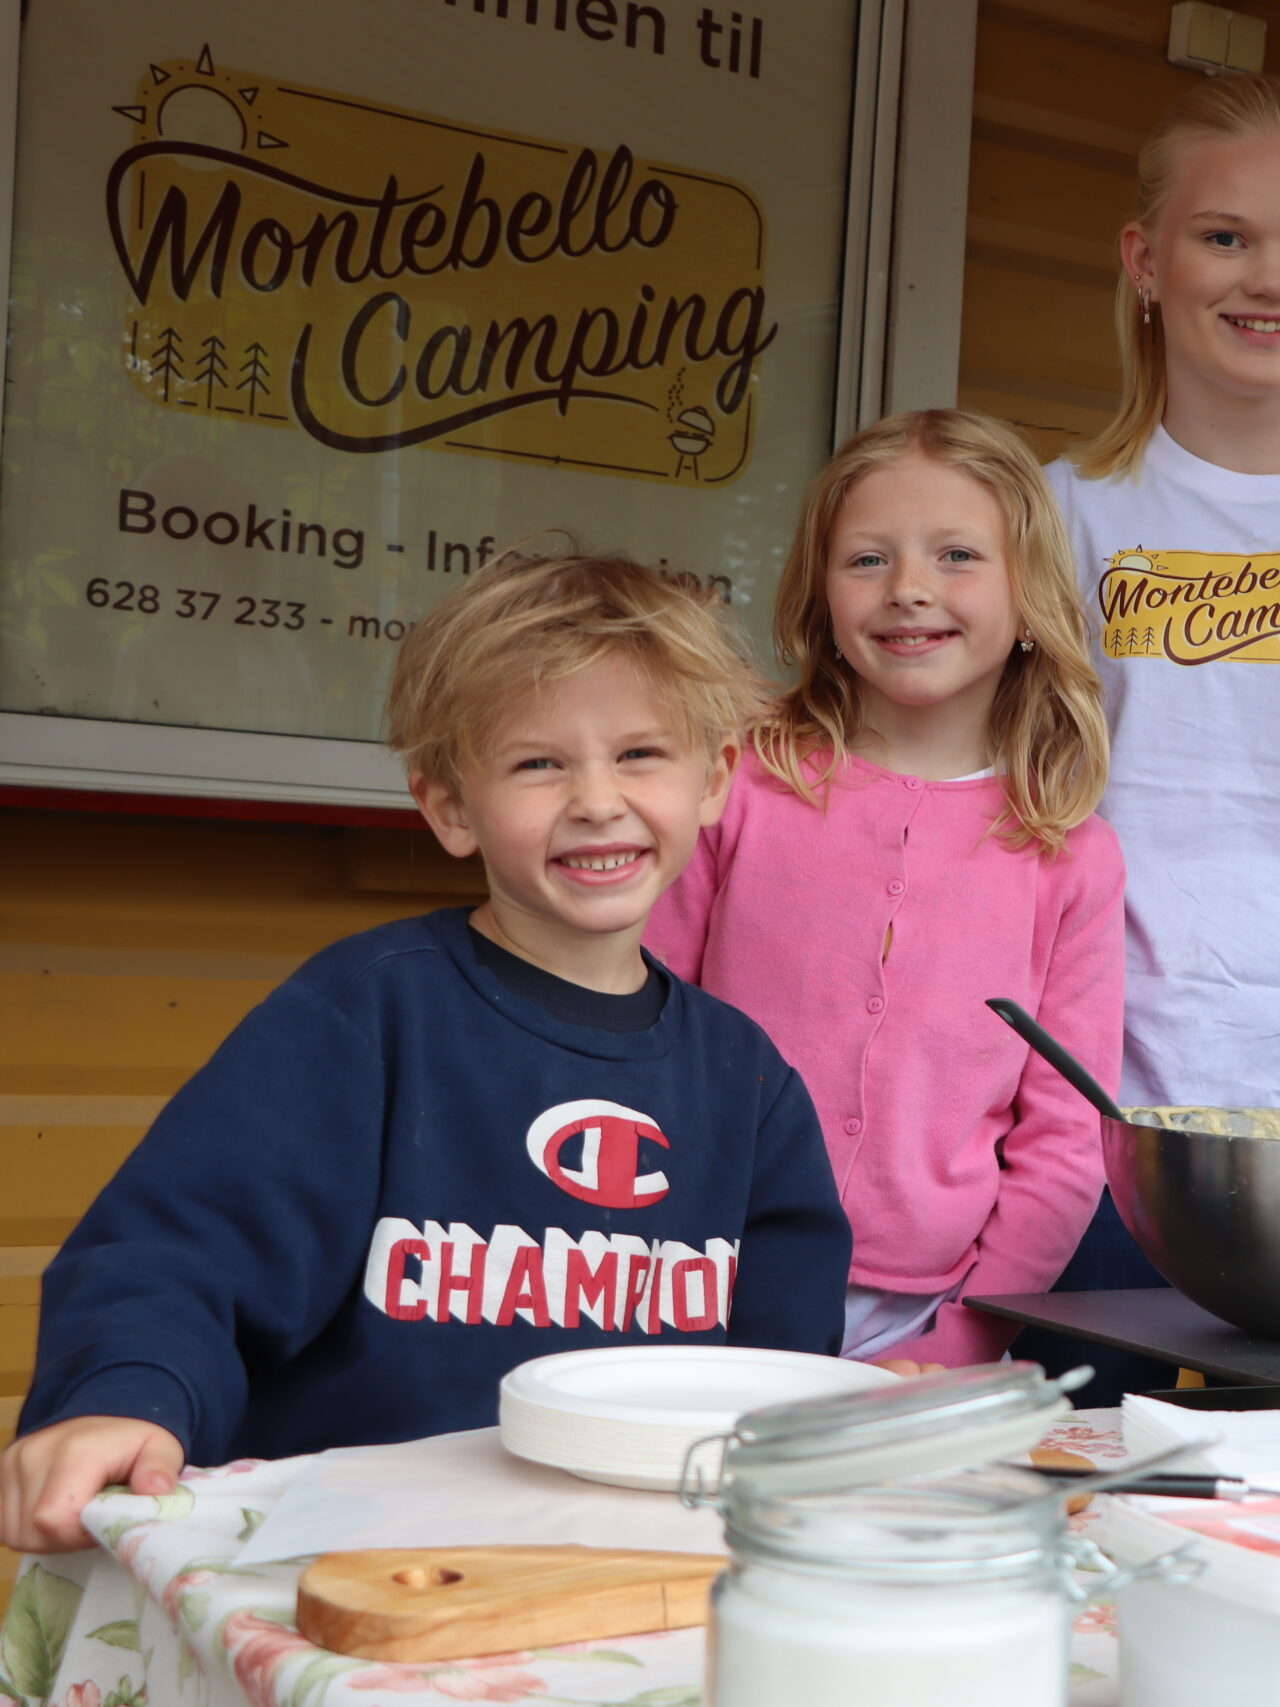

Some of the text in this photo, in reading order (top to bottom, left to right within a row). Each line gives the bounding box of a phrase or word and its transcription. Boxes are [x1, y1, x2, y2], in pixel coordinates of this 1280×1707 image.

[696, 8, 763, 79] til
[106, 140, 678, 306] Montebello
[341, 284, 778, 416] Camping
[118, 488, 366, 570] Booking
[85, 577, 161, 616] 628
[174, 588, 221, 621] 37
[234, 596, 307, 632] 233
[363, 1216, 742, 1336] CHAMPIO
